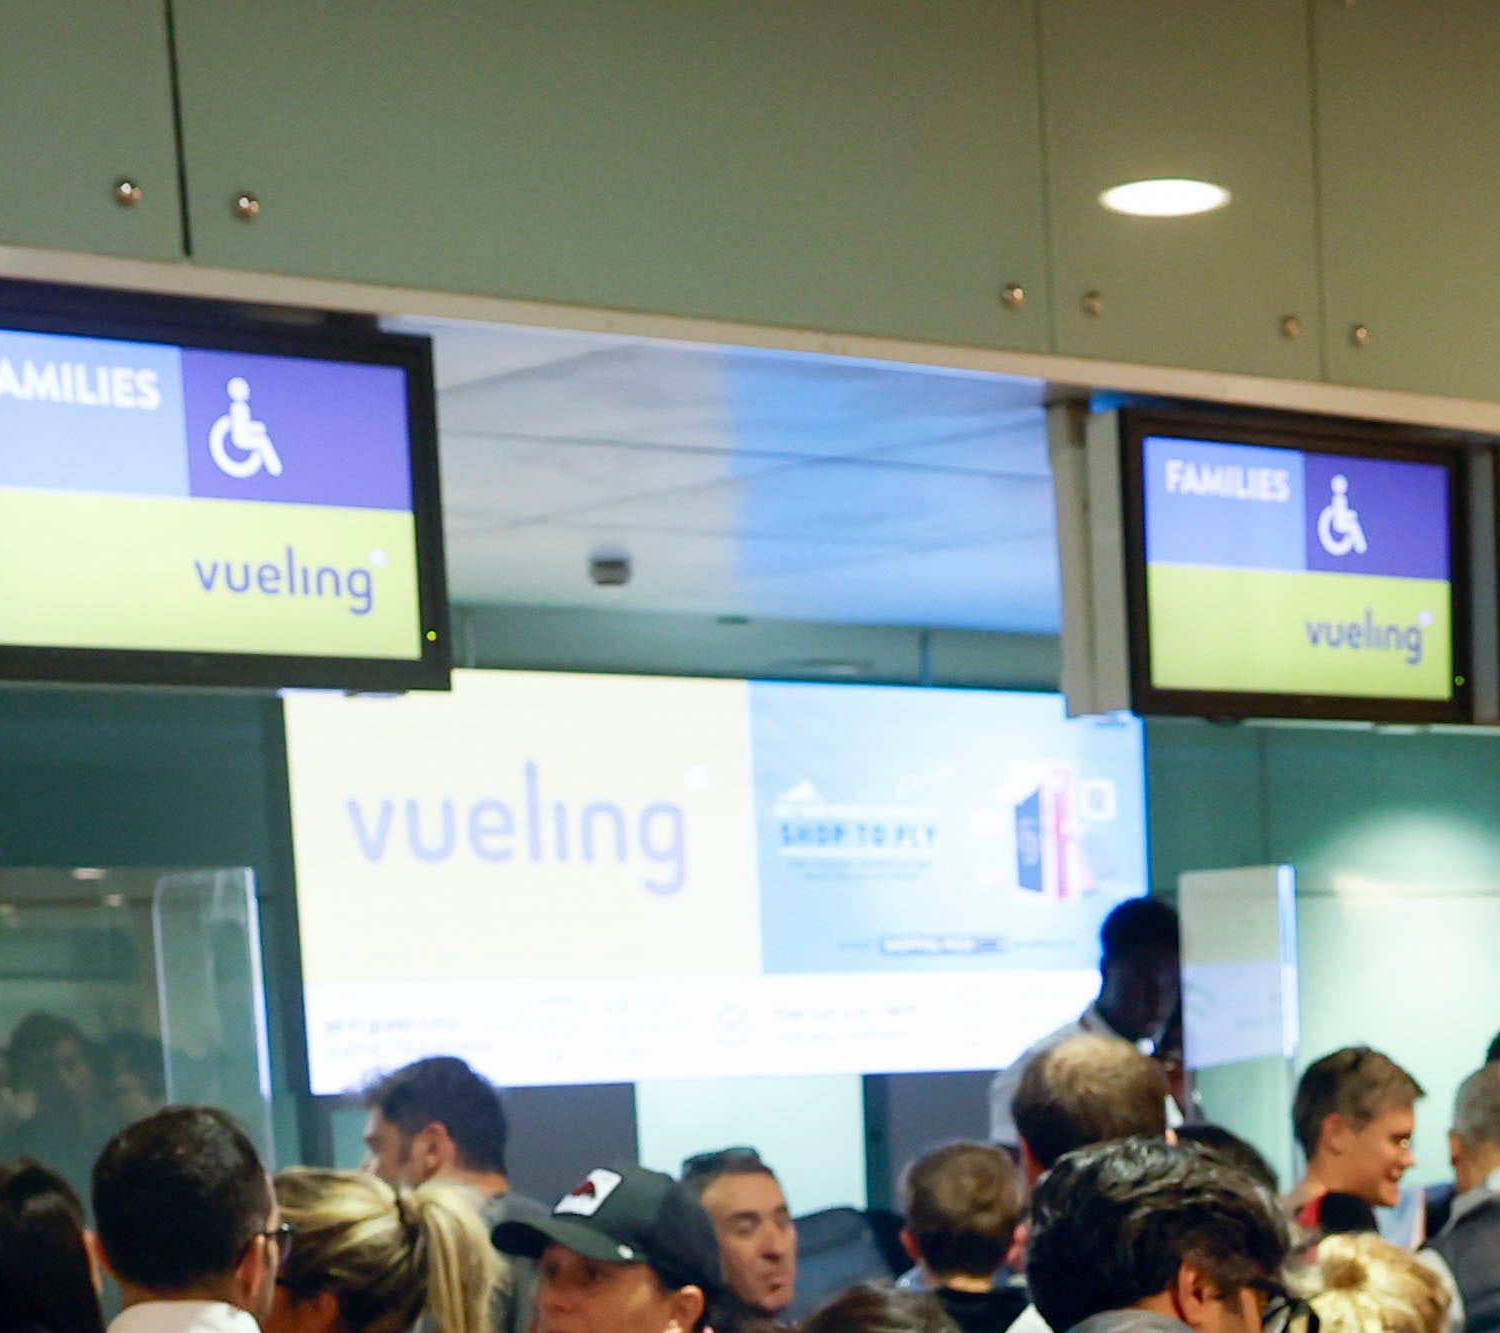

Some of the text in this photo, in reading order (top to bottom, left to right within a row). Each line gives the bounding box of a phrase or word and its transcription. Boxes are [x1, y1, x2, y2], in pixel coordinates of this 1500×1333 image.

[1164, 457, 1291, 504] FAMILIES
[192, 546, 376, 618] vueling
[1304, 608, 1425, 667] vueling
[344, 758, 690, 896] vueling
